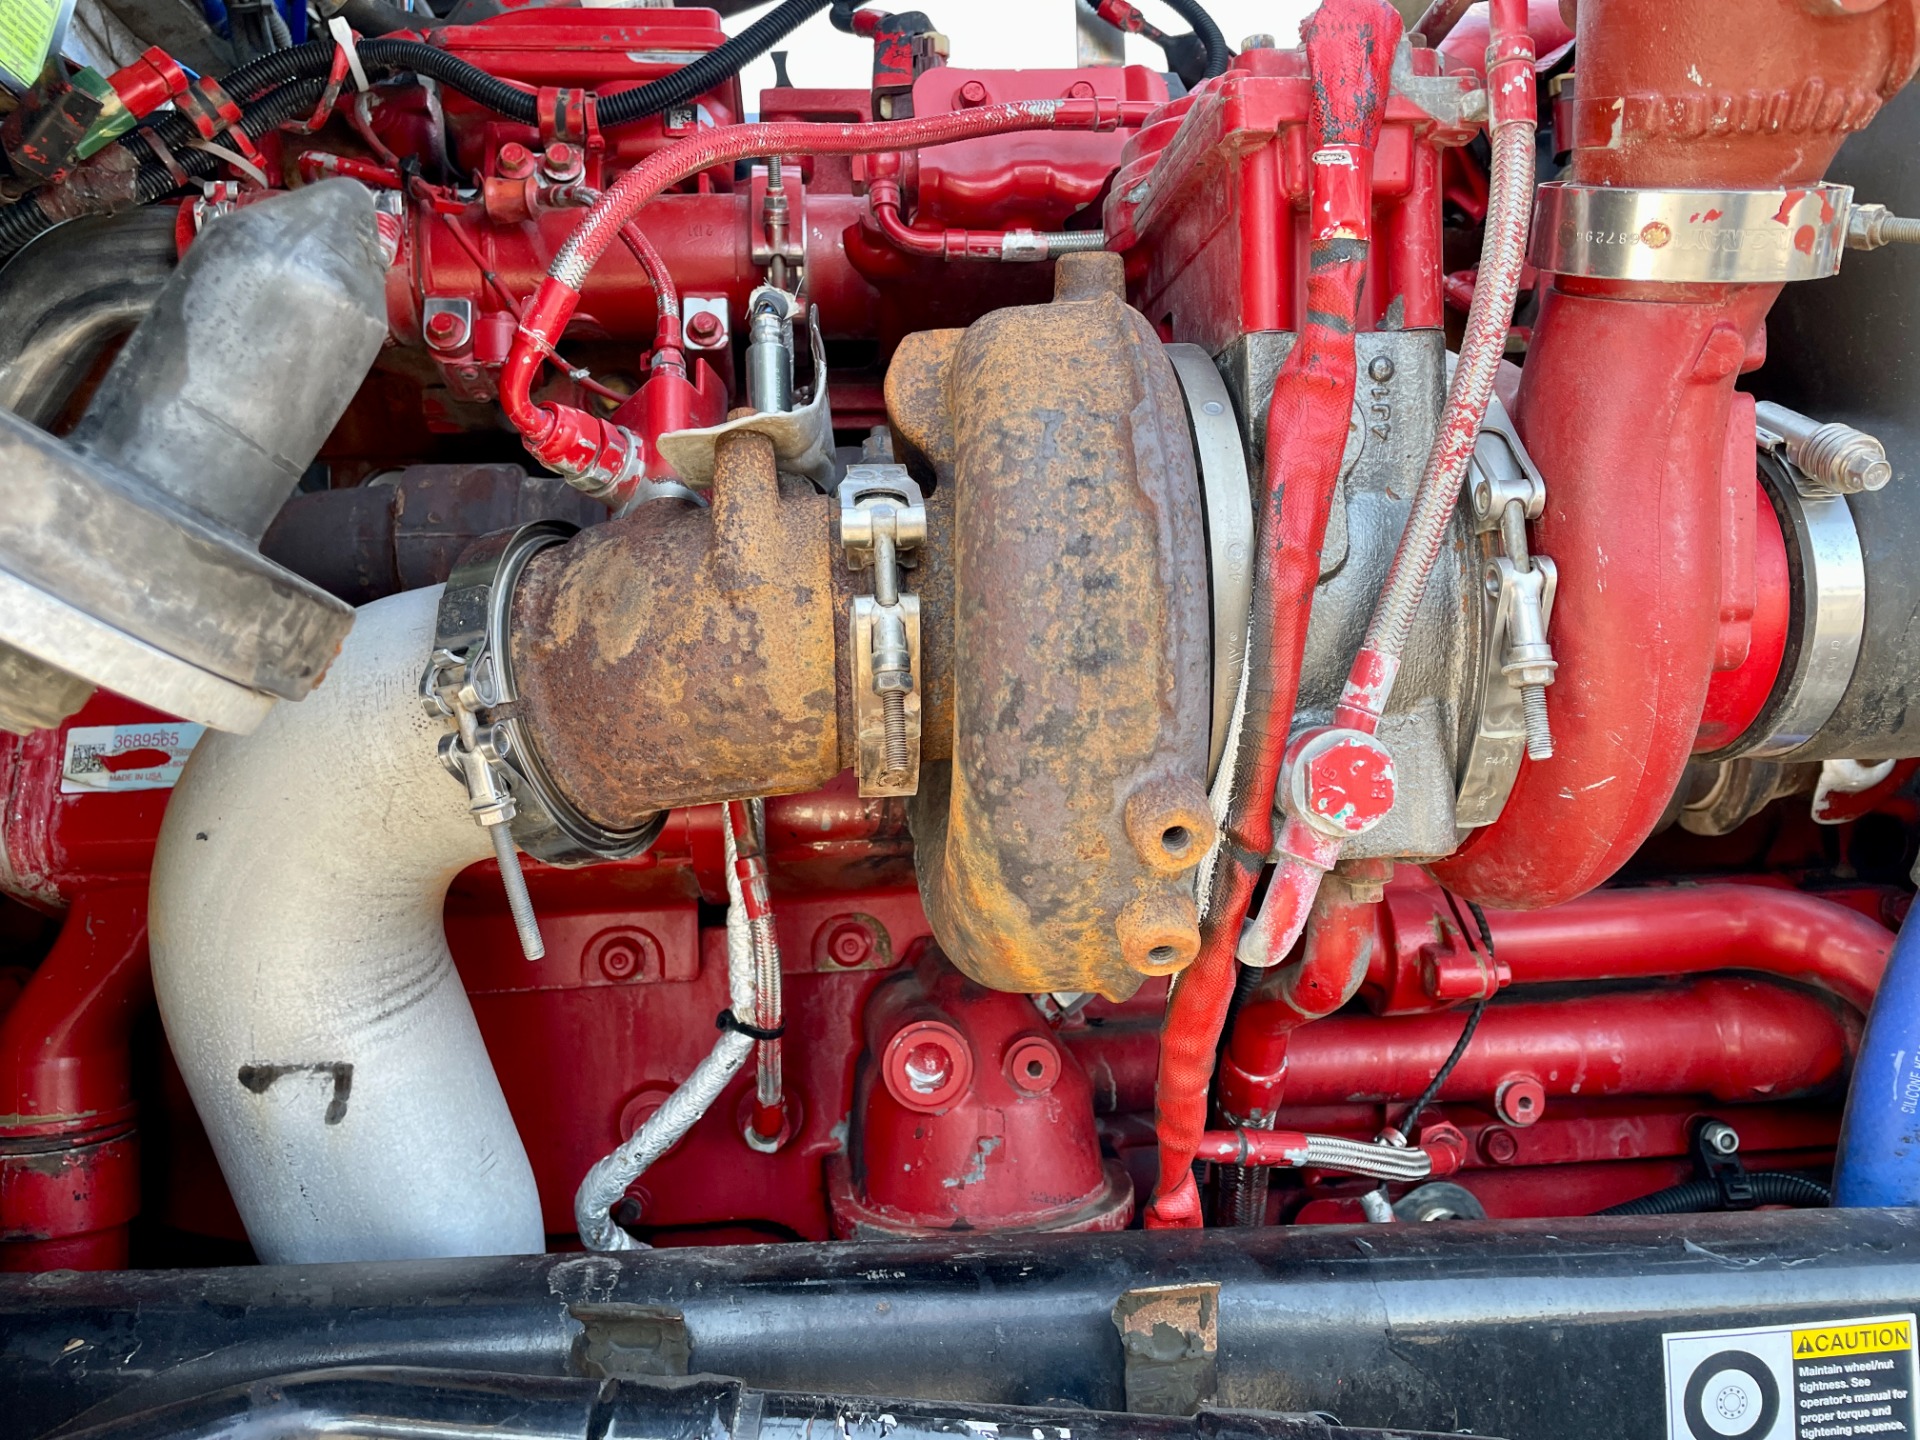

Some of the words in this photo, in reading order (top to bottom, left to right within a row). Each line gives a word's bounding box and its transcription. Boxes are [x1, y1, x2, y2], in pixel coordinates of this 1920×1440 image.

[113, 731, 180, 749] 3689565
[109, 772, 132, 782] MADE
[134, 772, 144, 781] IN
[145, 771, 162, 781] USA
[1815, 1327, 1908, 1351] CAUTION
[1799, 1364, 1843, 1377] Maintain
[1844, 1359, 1895, 1372] wheel/nut
[1799, 1380, 1849, 1394] tightness.
[1851, 1377, 1871, 1388] See
[1800, 1394, 1852, 1409] operator's
[1854, 1390, 1891, 1403] manual
[1891, 1389, 1908, 1399] for
[1800, 1412, 1835, 1425] proper
[1836, 1409, 1870, 1420] torque
[1871, 1405, 1892, 1416] and
[1801, 1425, 1852, 1440] tightening
[1854, 1421, 1906, 1435] sequence.
